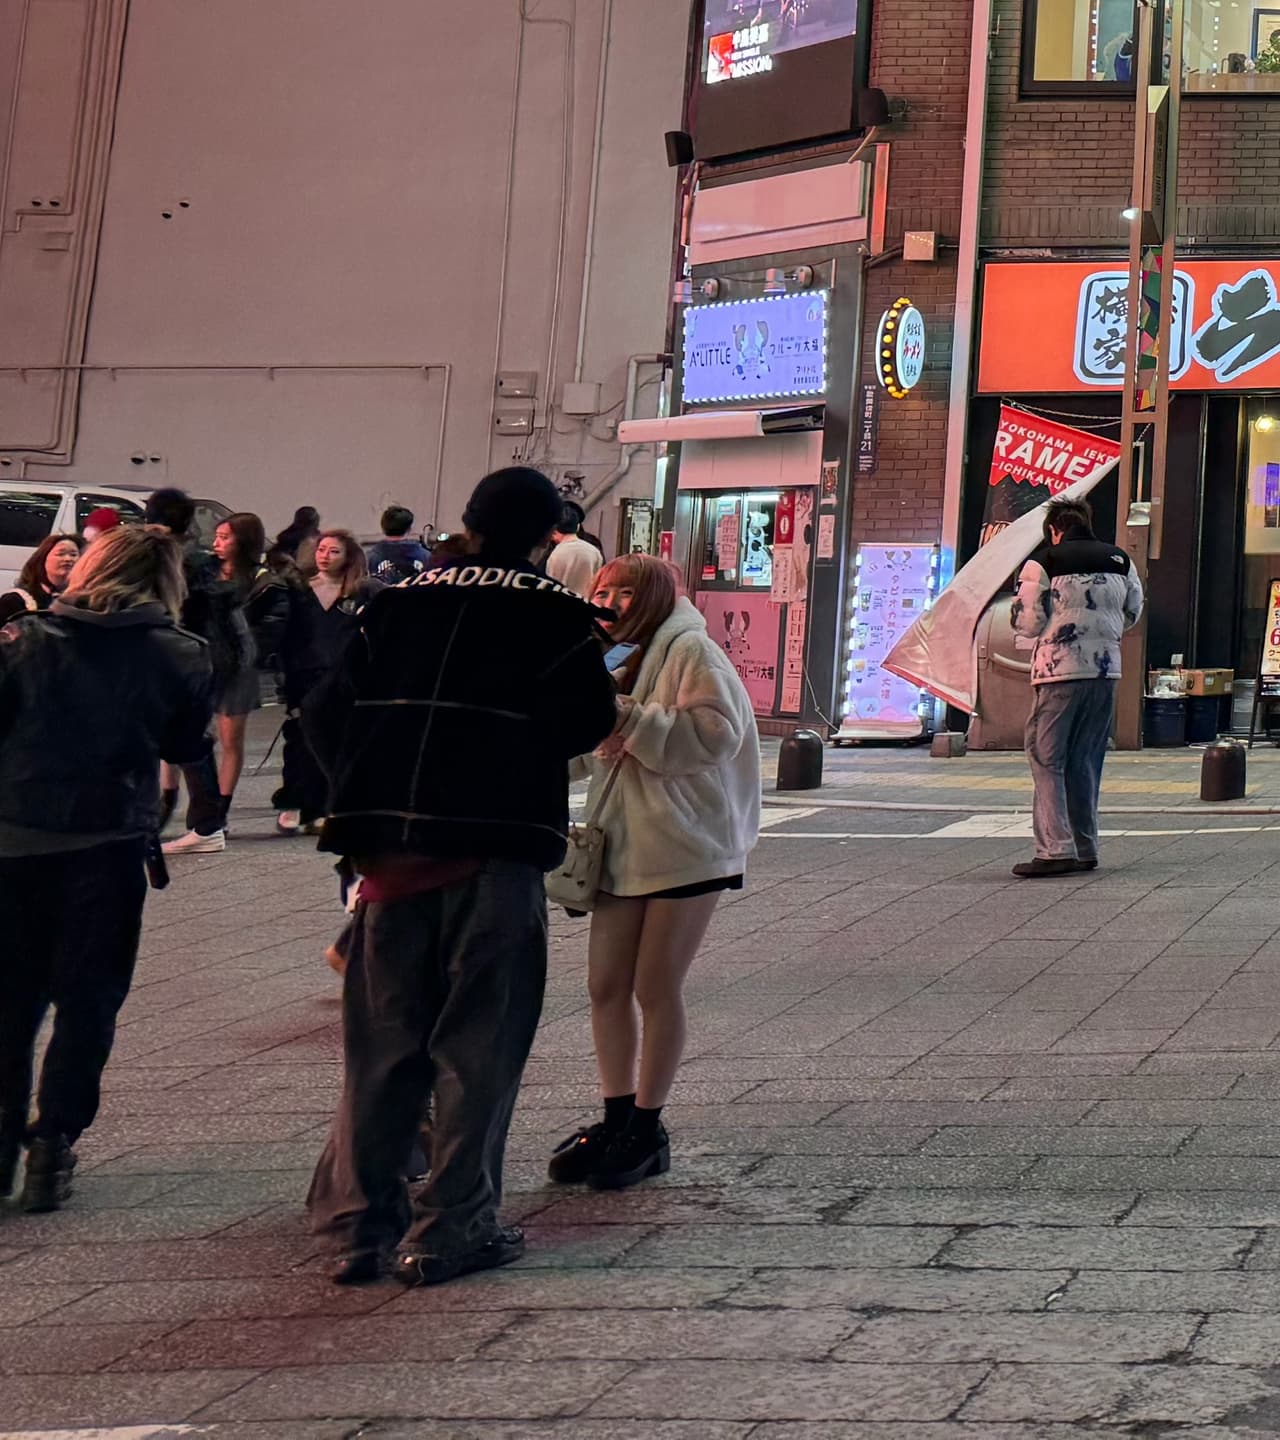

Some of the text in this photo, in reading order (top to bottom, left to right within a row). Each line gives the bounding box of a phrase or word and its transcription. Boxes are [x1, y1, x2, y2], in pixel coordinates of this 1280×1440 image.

[861, 441, 872, 451] 21
[1000, 420, 1074, 453] YOKOHAMA
[994, 431, 1104, 481] RAME
